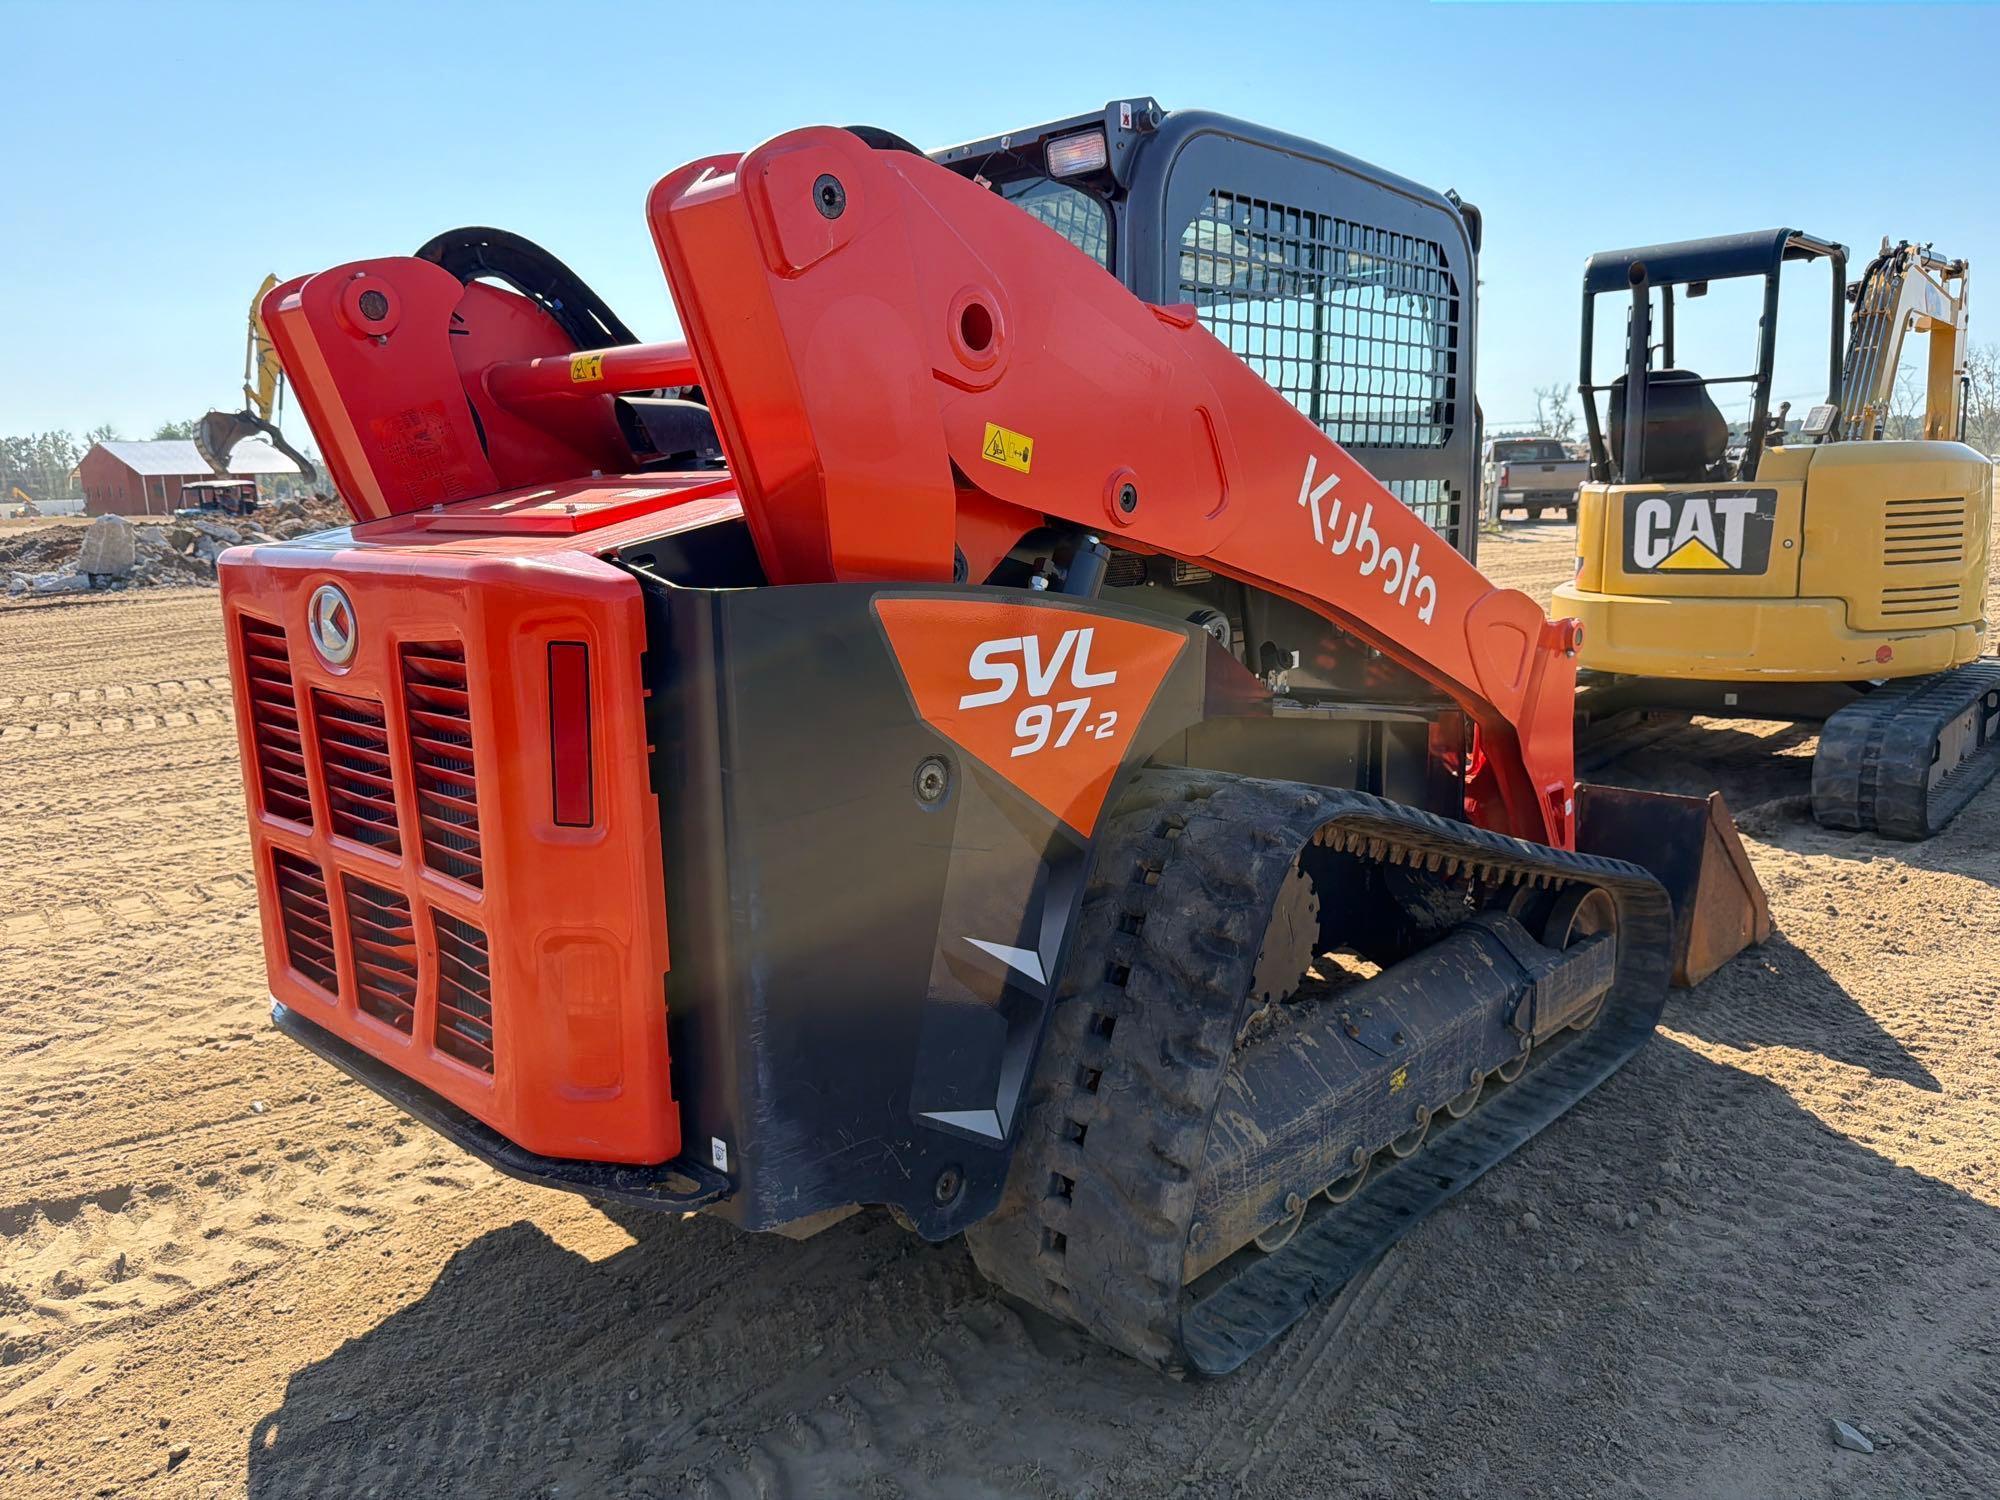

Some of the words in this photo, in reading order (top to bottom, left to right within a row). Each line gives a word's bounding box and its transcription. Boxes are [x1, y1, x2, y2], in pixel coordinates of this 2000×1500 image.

[1297, 454, 1437, 626] Kubota
[1633, 497, 1758, 570] CAT
[958, 627, 1117, 710] SVL
[1010, 696, 1118, 758] 97-2
